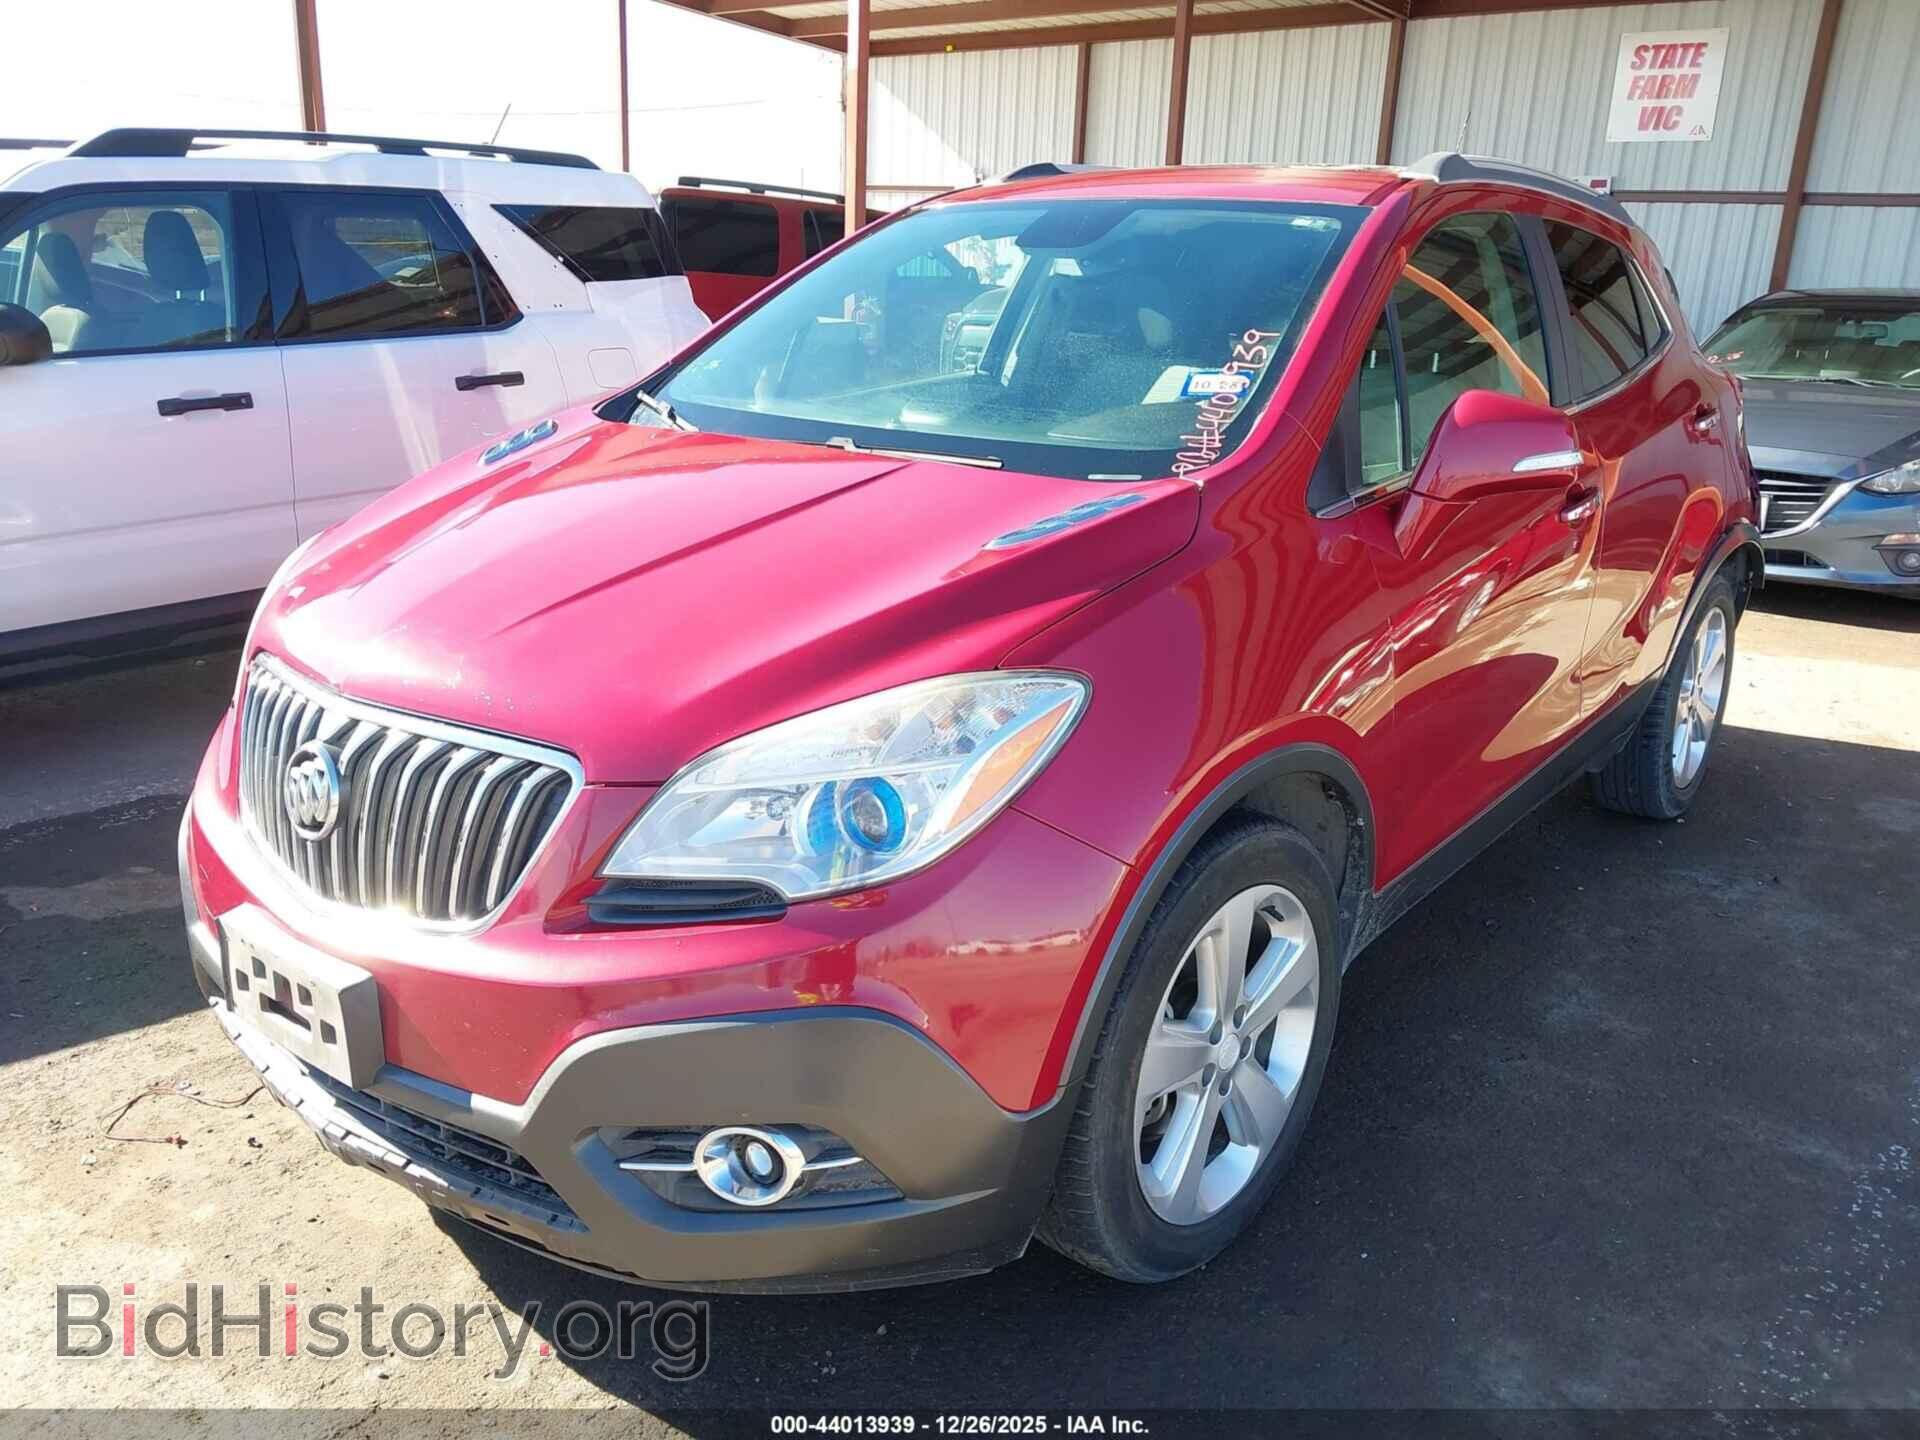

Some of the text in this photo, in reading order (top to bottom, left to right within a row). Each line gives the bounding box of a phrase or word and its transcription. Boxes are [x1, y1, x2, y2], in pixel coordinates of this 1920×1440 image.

[1630, 42, 1709, 70] STATE
[1627, 73, 1701, 100] FARM
[1637, 105, 1684, 131] VIC
